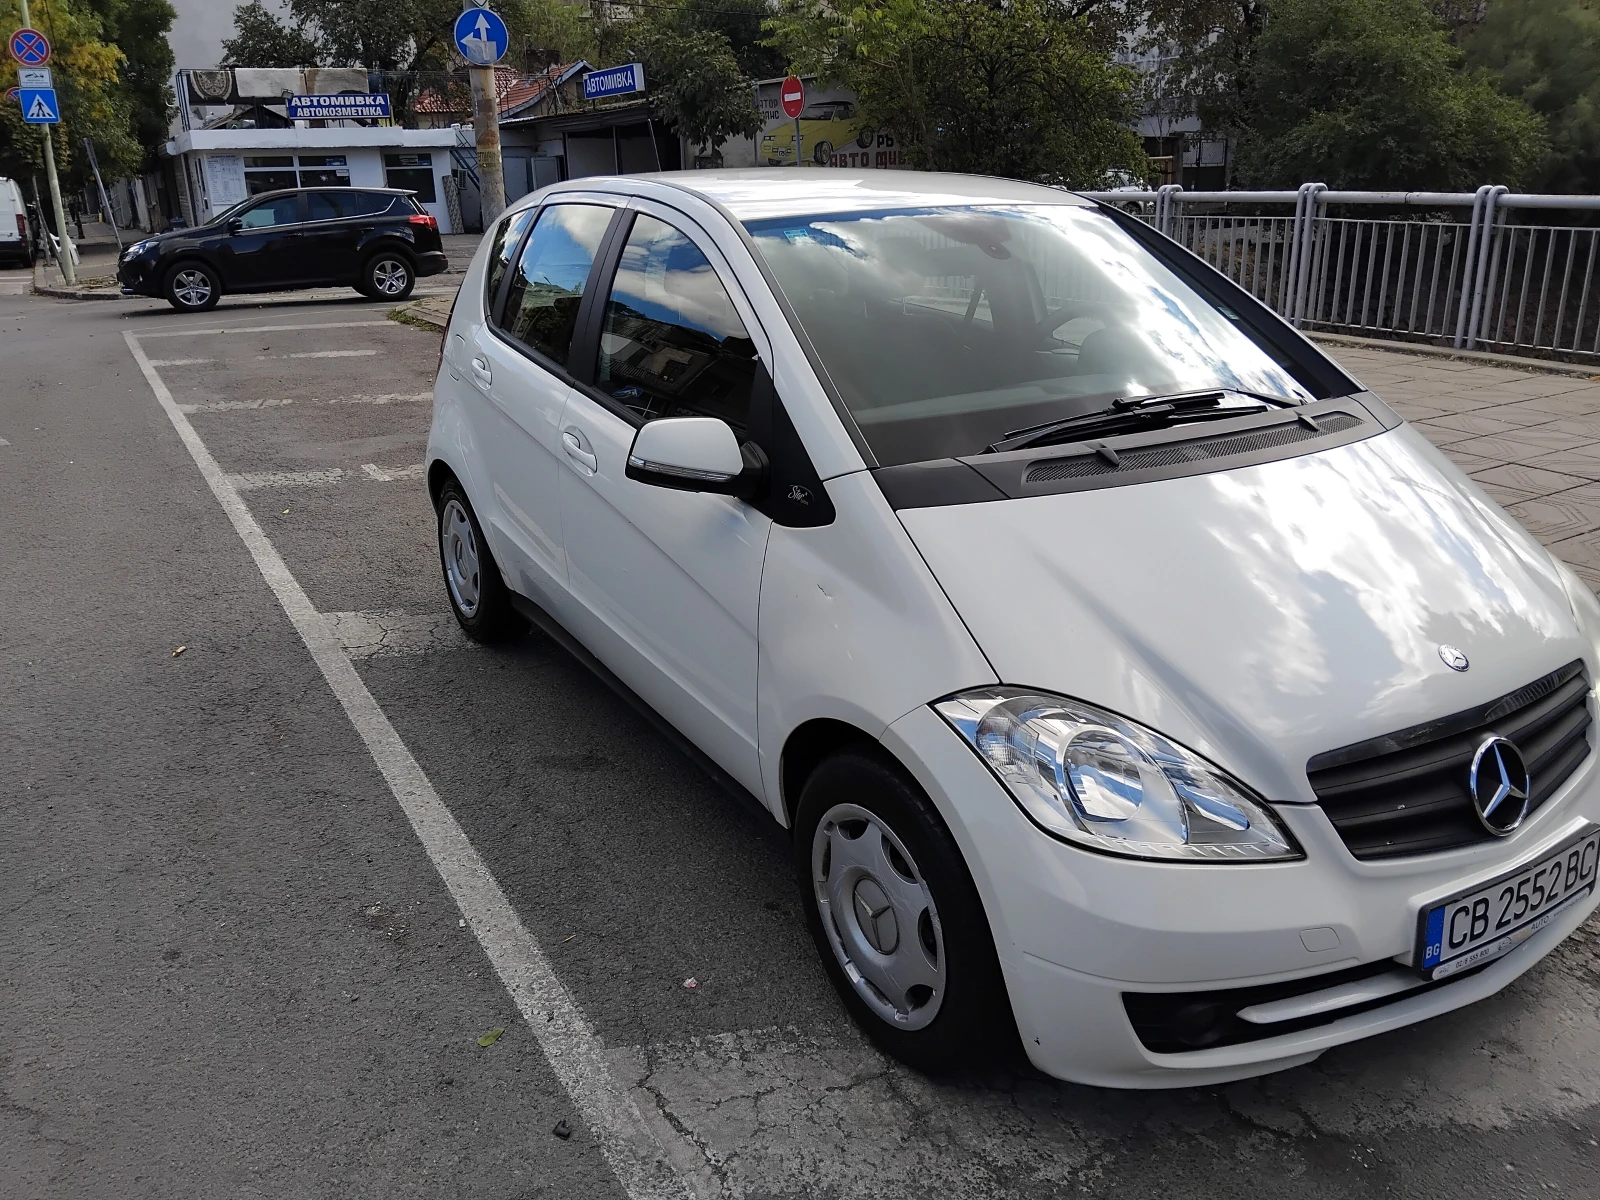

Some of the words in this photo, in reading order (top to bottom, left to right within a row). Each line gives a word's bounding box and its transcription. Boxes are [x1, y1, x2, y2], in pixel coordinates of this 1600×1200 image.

[586, 70, 634, 94] АВТОМИВКА
[291, 96, 385, 106] АВТОМИВКА
[297, 106, 383, 117] АВТОКОЗМЕТИКА
[829, 151, 870, 168] АВТО
[1448, 897, 1490, 950] CB
[1495, 860, 1562, 931] 2552
[1564, 840, 1596, 894] BC
[1531, 915, 1550, 931] AUTO
[1425, 943, 1440, 960] BG
